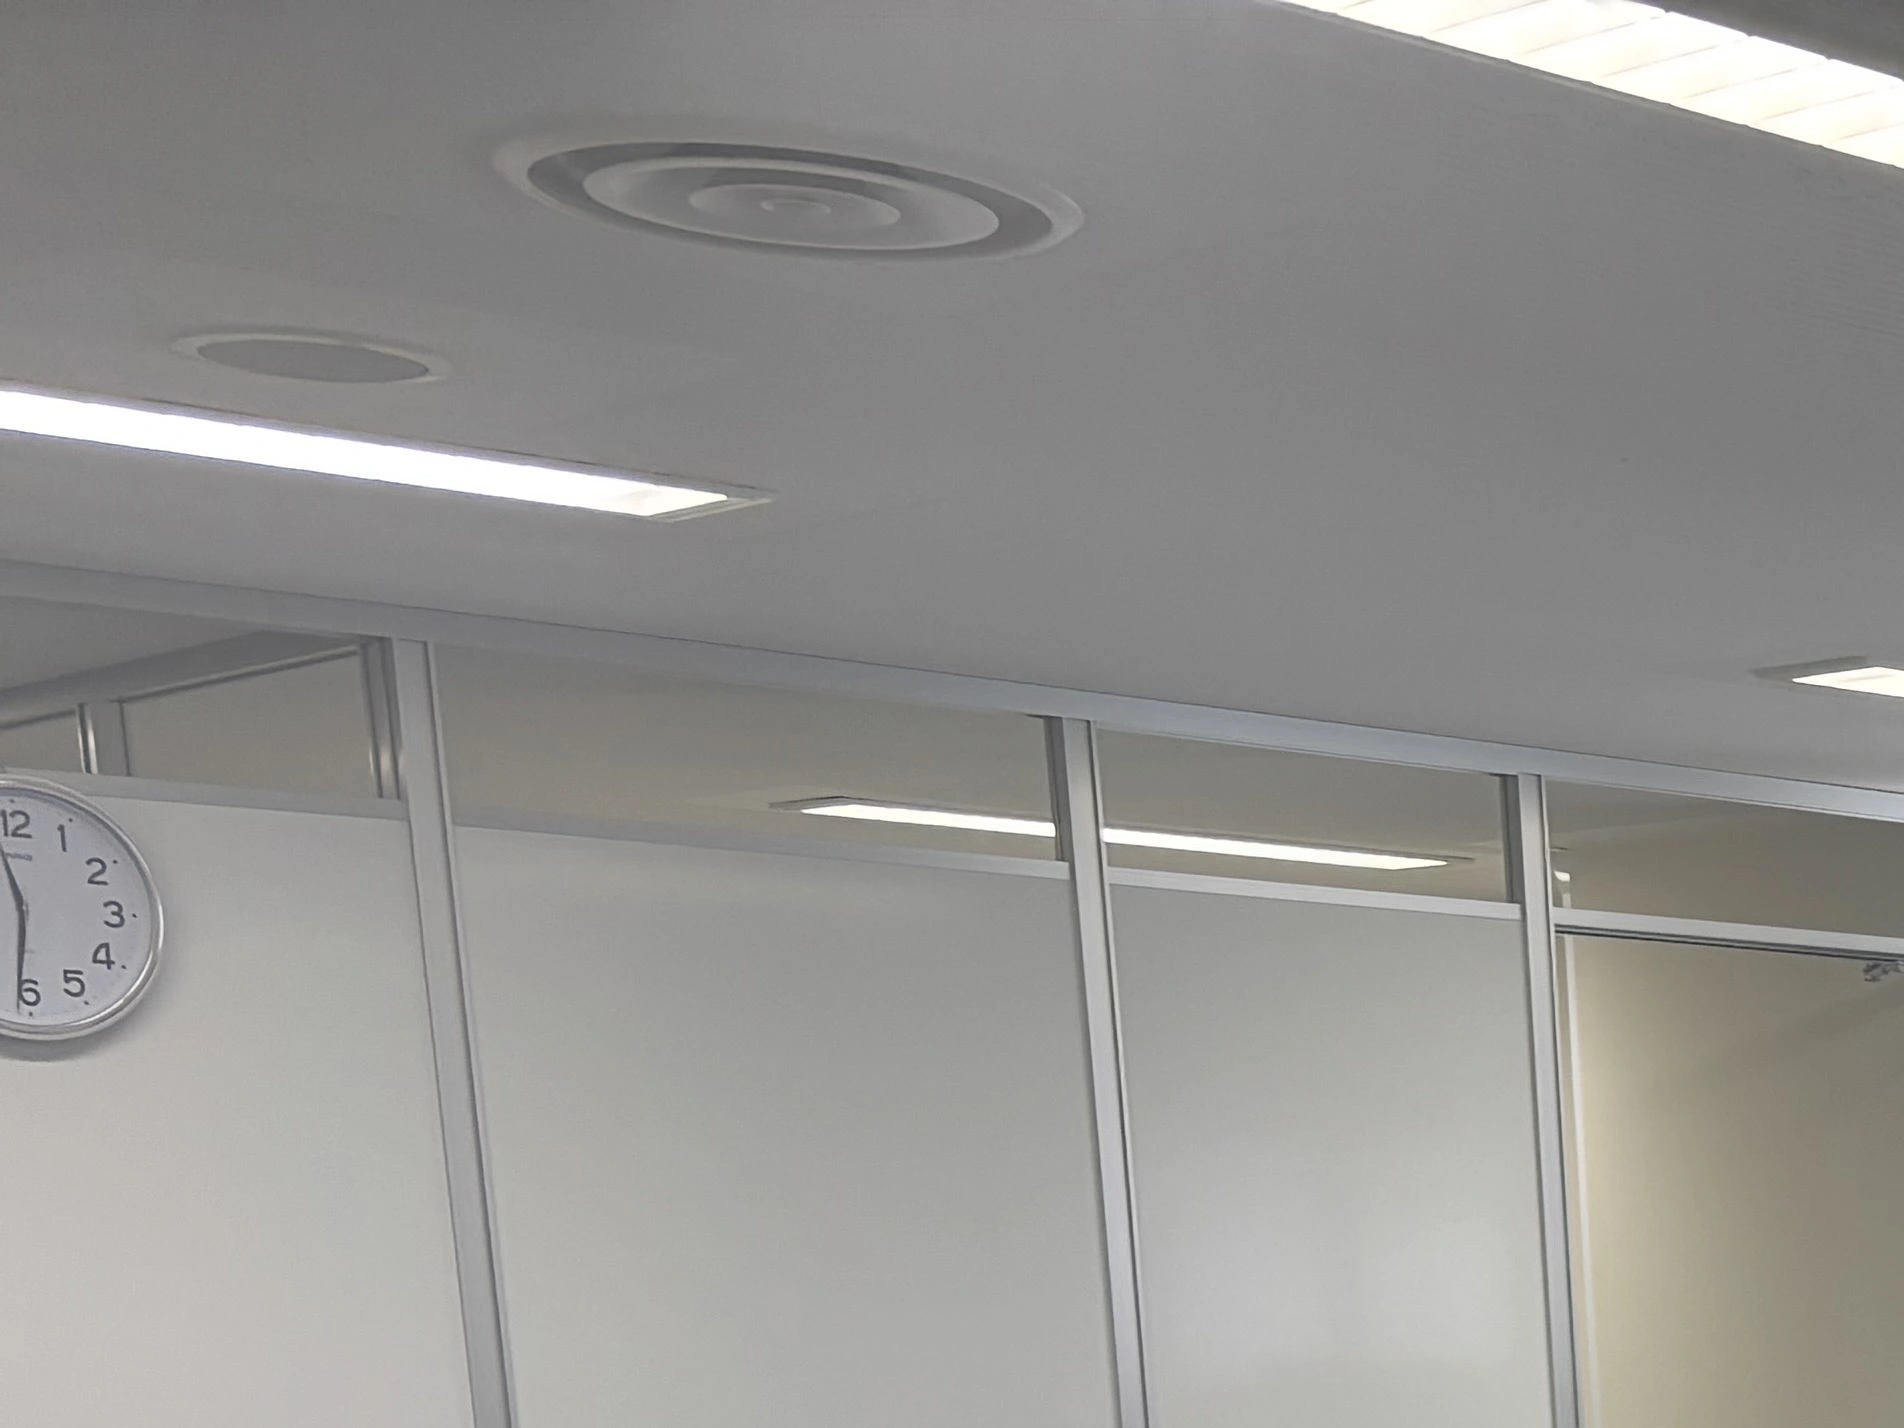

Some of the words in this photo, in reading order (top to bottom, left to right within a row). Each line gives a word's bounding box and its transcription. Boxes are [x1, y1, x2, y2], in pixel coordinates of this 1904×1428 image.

[56, 824, 68, 852] 1
[86, 858, 108, 886] 2
[103, 901, 125, 928] 3
[92, 942, 116, 969] 4
[20, 979, 41, 1006] 6
[63, 969, 85, 998] 5
